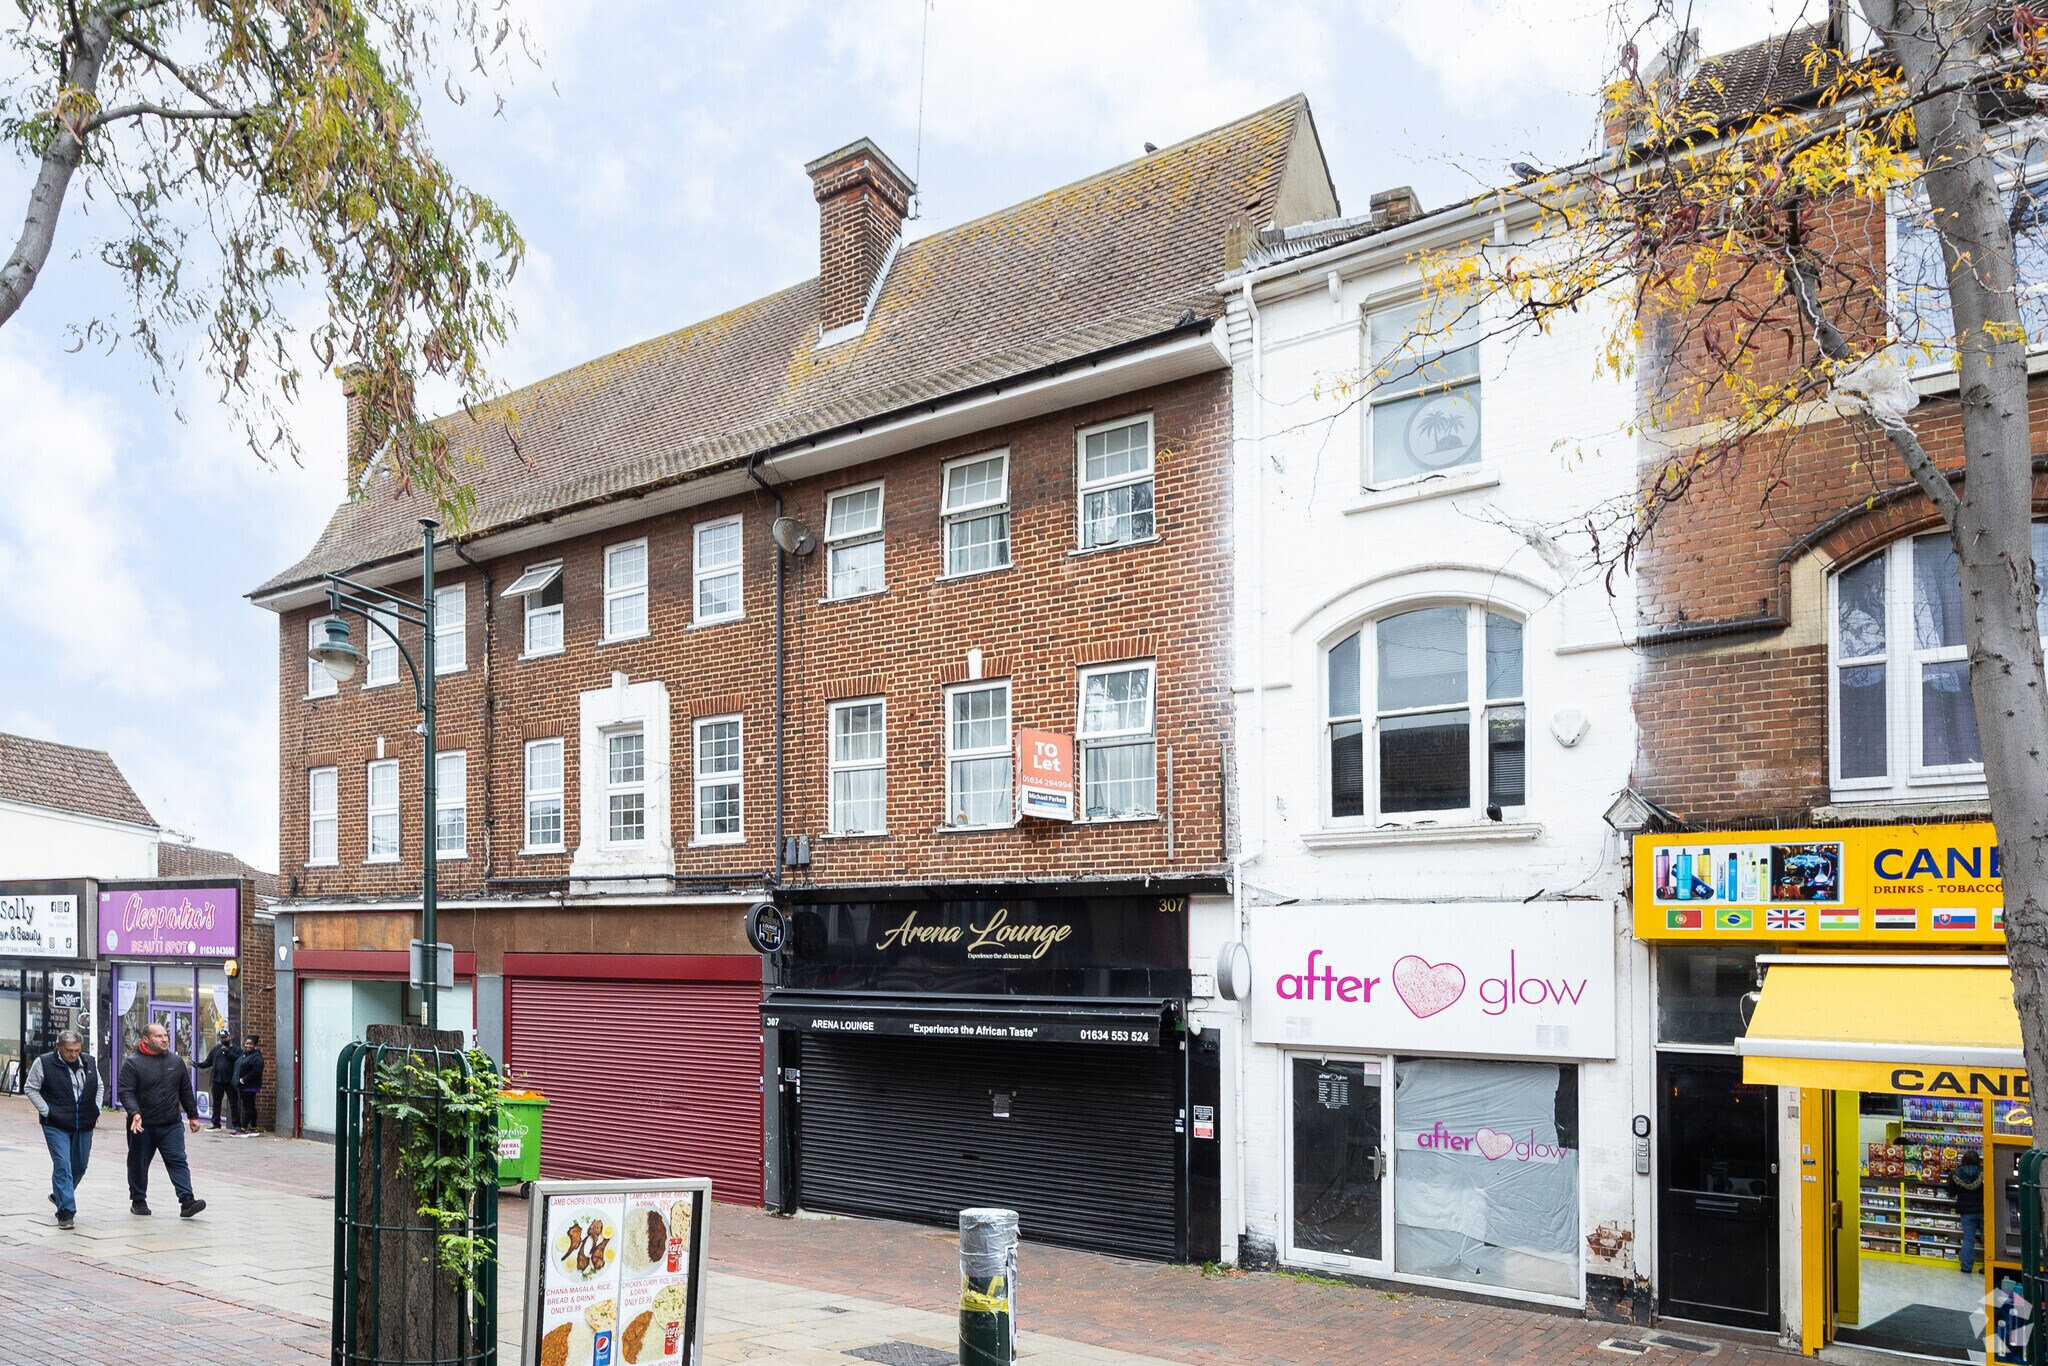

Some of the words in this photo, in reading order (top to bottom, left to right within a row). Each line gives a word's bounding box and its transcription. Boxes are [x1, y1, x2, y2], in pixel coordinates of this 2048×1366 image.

[1034, 741, 1058, 758] TO
[1033, 755, 1060, 772] Let
[1022, 775, 1043, 785] 01634
[1873, 885, 1924, 894] DRINKS
[0, 897, 35, 925] Solly
[1159, 898, 1185, 912] 307
[123, 892, 215, 941] Cleopatra's
[876, 910, 964, 950] Arena
[967, 908, 1073, 959] Lounge
[1276, 949, 1380, 1003] after
[1479, 949, 1587, 1015] glow
[766, 1017, 780, 1027] 307
[811, 1019, 839, 1029] ARENA
[840, 1020, 874, 1031] LOUNGE
[960, 1026, 974, 1035] the
[975, 1026, 1007, 1037] African
[1080, 1029, 1109, 1041] 01634
[1111, 1030, 1129, 1042] 553
[1131, 1031, 1149, 1042] 524
[1417, 1121, 1474, 1151] after
[1515, 1129, 1568, 1161] glow
[551, 1198, 565, 1207] LAMB
[567, 1197, 585, 1206] CHOPS
[622, 1280, 642, 1289] CHICKEN
[547, 1296, 568, 1305] BREAD
[624, 1298, 638, 1306] ONLY
[551, 1306, 566, 1315] ONLY
